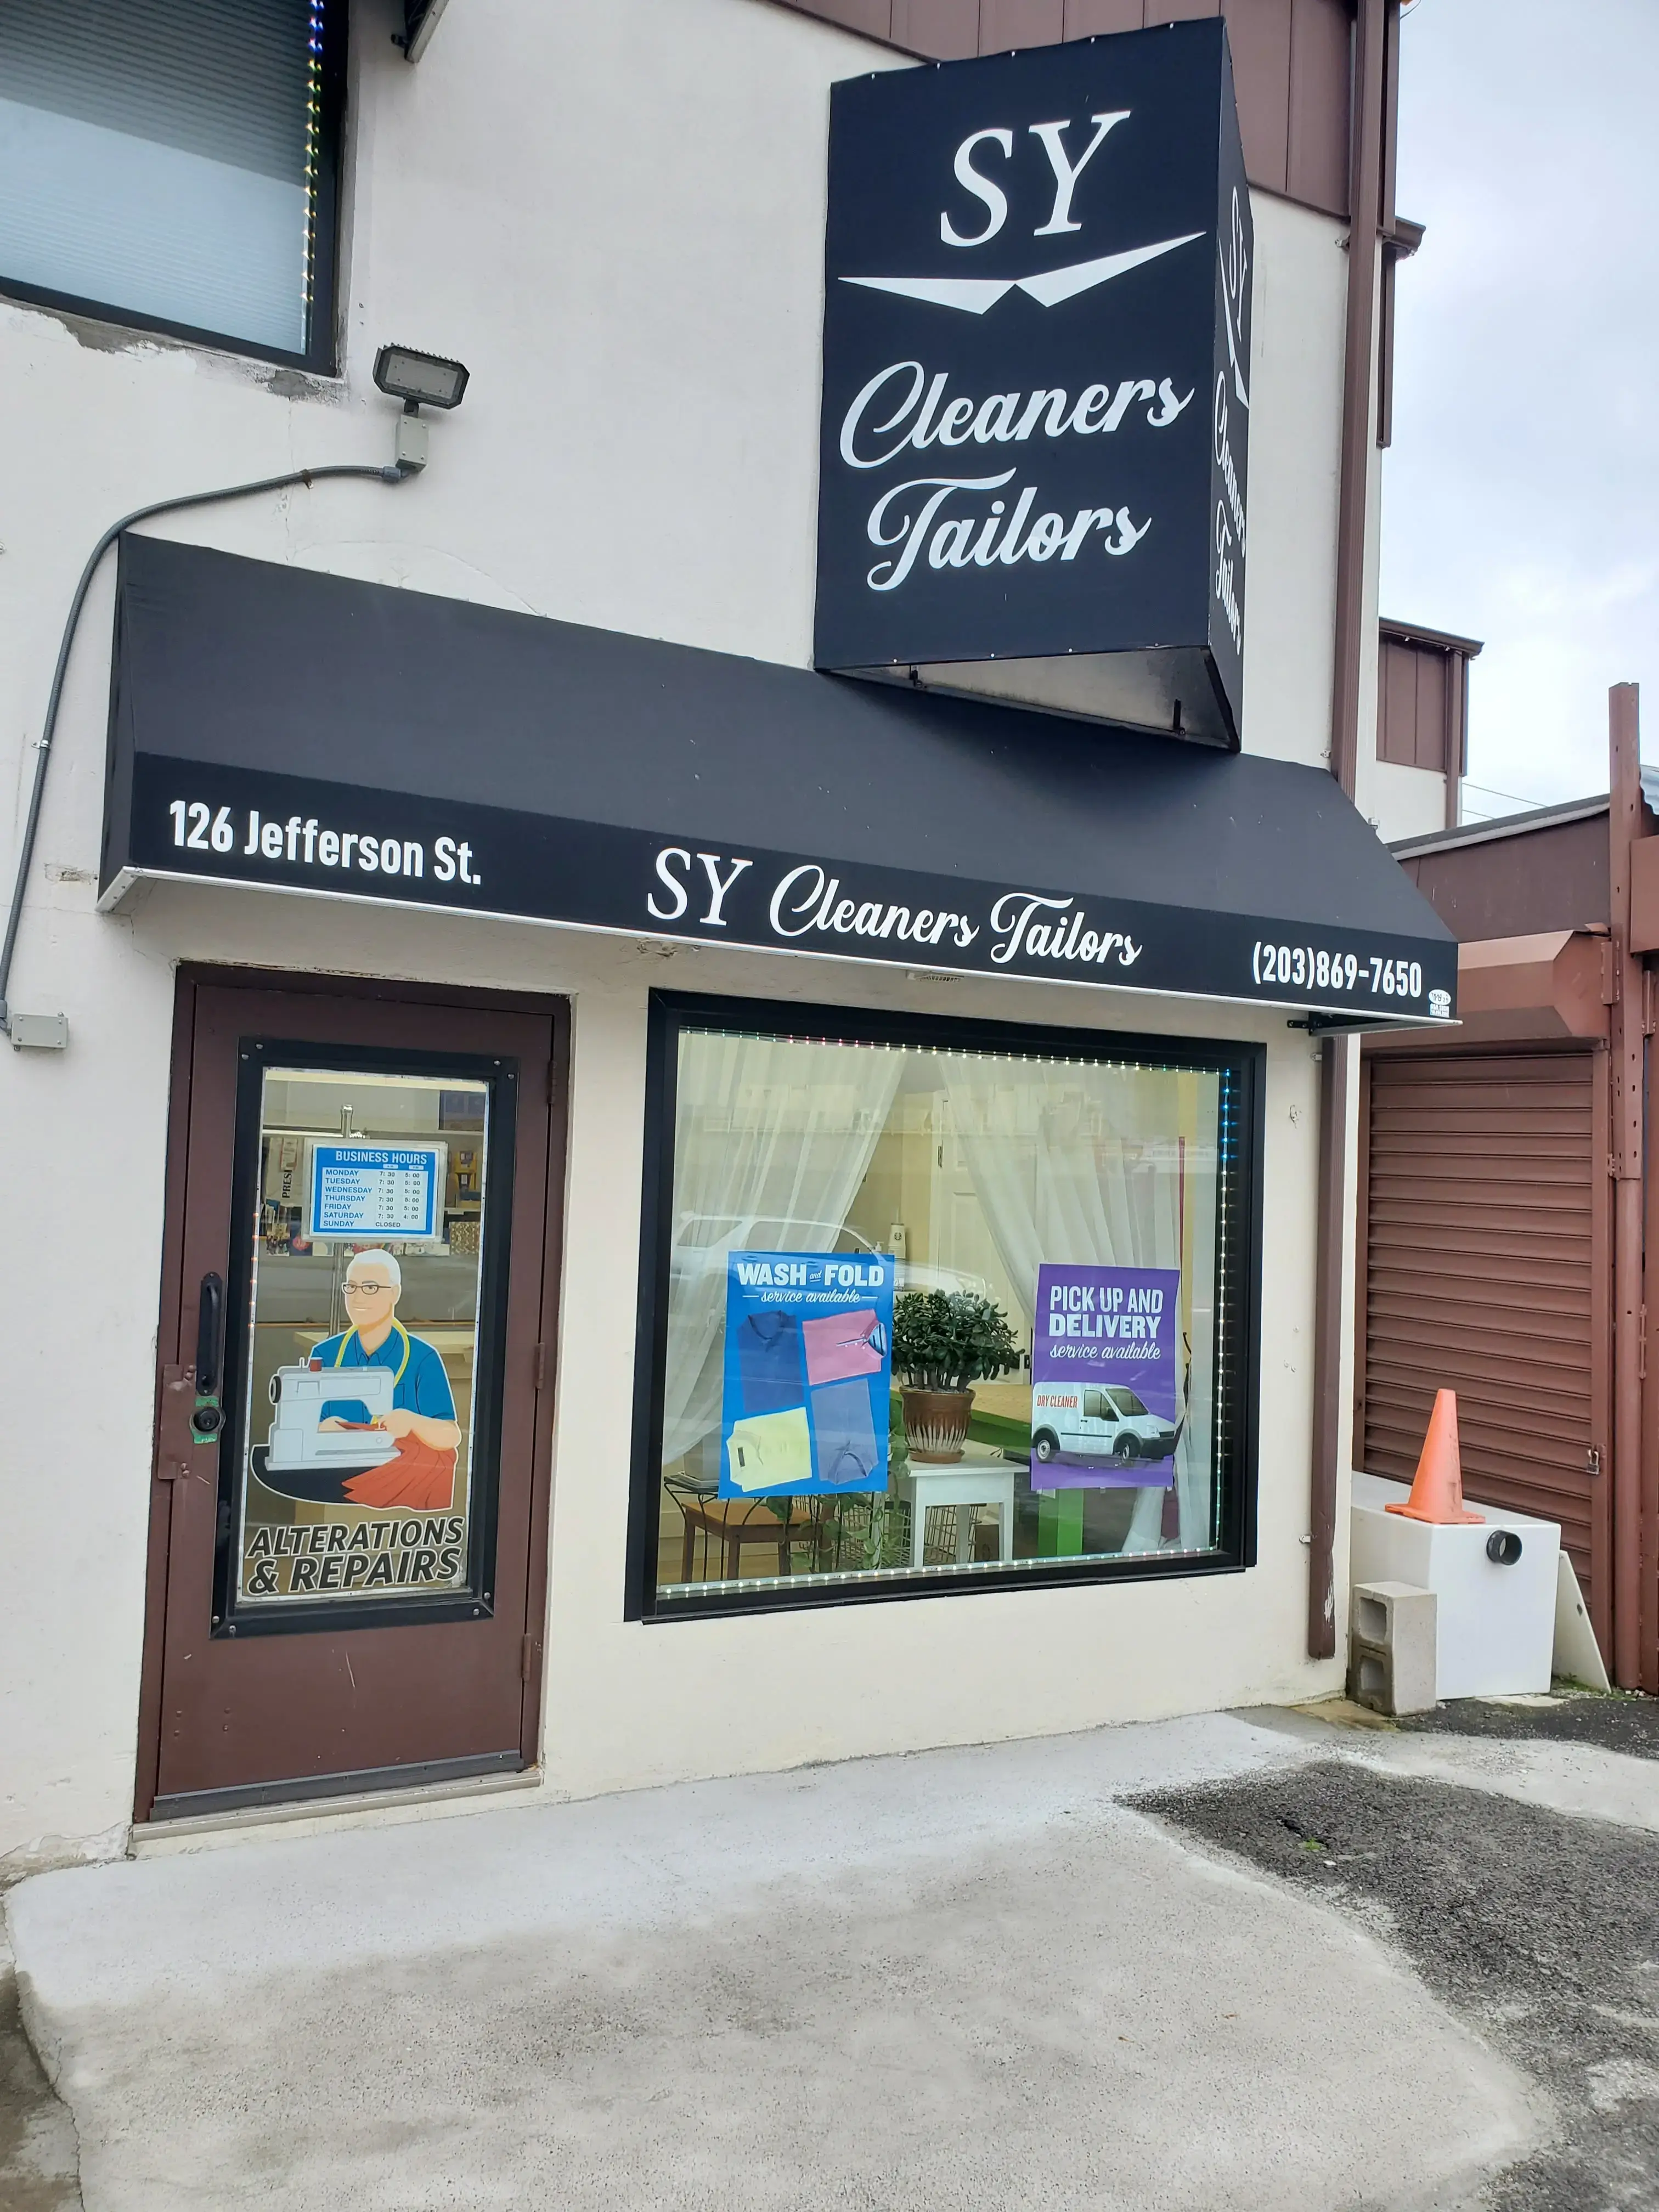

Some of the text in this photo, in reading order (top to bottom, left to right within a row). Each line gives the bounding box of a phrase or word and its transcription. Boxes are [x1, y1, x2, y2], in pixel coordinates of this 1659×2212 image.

[940, 110, 1130, 247] SY
[839, 360, 1195, 469] Cleaners
[866, 467, 1152, 591] Tailors
[170, 800, 481, 885] 126 Jefferson St.
[647, 848, 1143, 966] SY Cleaners Tailors
[1252, 941, 1422, 998] (203)869-7650
[336, 1150, 427, 1165] BUSINESS HOURS
[737, 1263, 884, 1286] WASH and FOLD
[761, 1288, 861, 1304] service available
[1049, 1285, 1164, 1313] PICK UP AND
[1049, 1313, 1161, 1338] DELIVERY
[1049, 1340, 1161, 1359] service available
[1037, 1395, 1078, 1409] DRY CLEANER
[246, 1516, 465, 1558] ALTERATIONS
[247, 1547, 462, 1595] & REPAIRS
